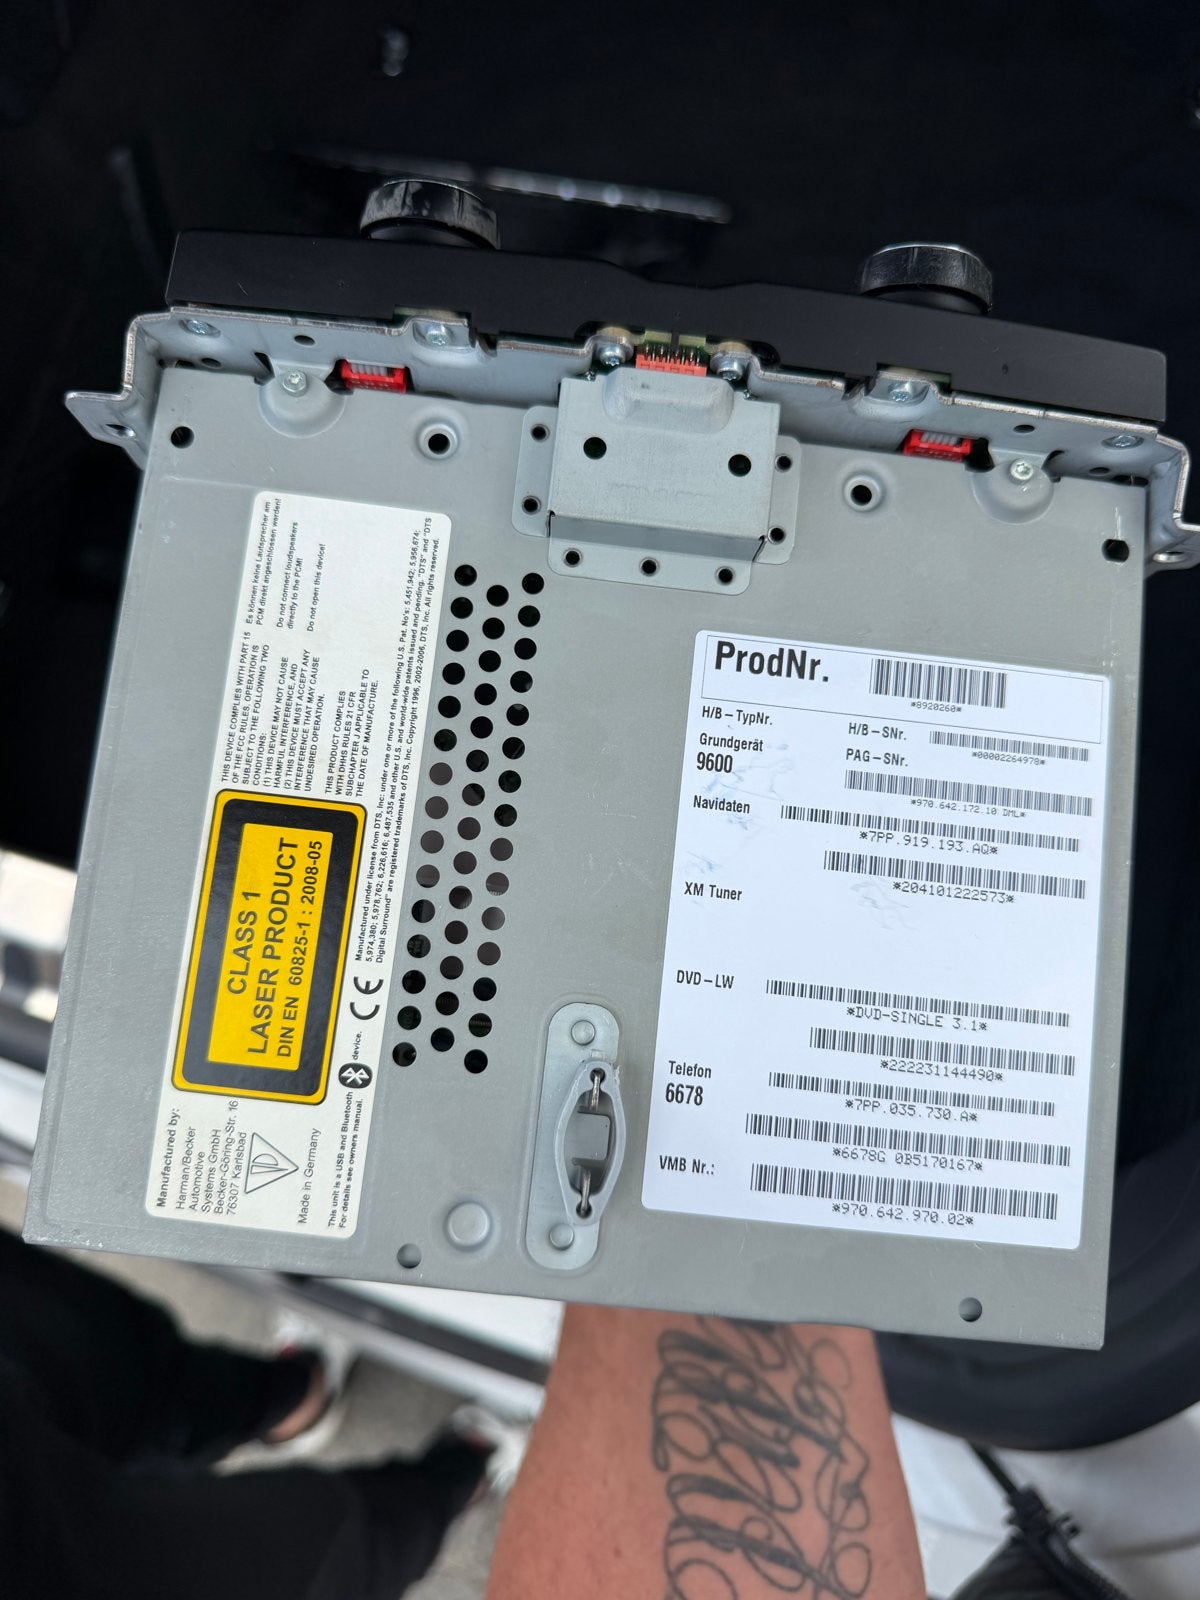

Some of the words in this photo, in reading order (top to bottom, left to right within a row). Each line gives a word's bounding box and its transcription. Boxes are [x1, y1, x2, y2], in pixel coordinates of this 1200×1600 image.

[263, 501, 271, 513] am
[272, 497, 281, 527] werden!
[254, 513, 268, 562] Lautsprecher
[284, 521, 298, 570] loudspeakers
[263, 528, 277, 584] angeschlossen
[293, 557, 303, 577] PCM!
[315, 543, 326, 570] device!
[251, 563, 261, 583] keine
[313, 570, 322, 585] this
[258, 584, 268, 606] direkt
[280, 571, 291, 602] connect
[290, 591, 298, 600] to
[291, 578, 300, 591] the
[311, 586, 319, 605] open
[246, 584, 258, 613] können
[244, 613, 254, 624] Es
[255, 606, 265, 625] PCM
[275, 616, 284, 628] Do
[286, 600, 298, 629] directly
[309, 606, 317, 619] not
[242, 631, 251, 640] 15
[305, 620, 315, 632] Do
[239, 641, 249, 664] PART
[251, 644, 259, 653] IS
[260, 643, 270, 663] TWO
[301, 648, 310, 667] ANY
[277, 656, 288, 685] CAUSE
[309, 656, 320, 684] CAUSE
[714, 640, 828, 682] ProdNr.
[235, 664, 246, 686] WITH
[243, 653, 258, 701] OPERATION
[296, 667, 307, 701] ACCEPT
[252, 664, 266, 713] FOLLOWING
[274, 685, 284, 703] NOT
[306, 685, 315, 703] MAY
[347, 690, 356, 708] CFR
[229, 687, 242, 729] COMPLIES
[238, 703, 250, 733] RULES.
[271, 704, 281, 722] MAY
[292, 701, 303, 725] MUST
[302, 704, 312, 726] THAT
[333, 690, 346, 732] COMPLIES
[345, 709, 353, 719] 21
[362, 680, 378, 743] MANUFACTURE.
[249, 715, 259, 731] THE
[272, 748, 286, 788] HARMFUL
[279, 682, 296, 746] INTERFERENCE,
[288, 662, 298, 681] AND
[341, 720, 352, 748] RULES
[344, 740, 360, 796] SUBCHAPTER
[354, 681, 368, 733] APPLICABLE
[361, 668, 369, 680] TO
[387, 721, 395, 741] more
[223, 731, 236, 762] DEVICE
[235, 734, 246, 752] FCC
[247, 732, 256, 744] TO
[267, 724, 279, 754] DEVICE
[287, 726, 299, 757] DEVICE
[303, 743, 317, 791] UNDESIRED
[311, 693, 325, 742] OPERATION.
[385, 742, 392, 751] or
[699, 732, 763, 752] Grundgerät
[252, 732, 267, 786] CONDITIONS:
[293, 727, 309, 790] INTERFERENCE
[327, 733, 340, 774] PRODUCT
[337, 749, 348, 773] DHHS
[361, 744, 369, 756] OF
[383, 752, 391, 768] one
[220, 763, 231, 782] THIS
[233, 753, 243, 770] THE
[241, 746, 254, 784] SUBJECT
[263, 755, 274, 775] THIS
[284, 758, 295, 777] THIS
[357, 757, 368, 779] DATE
[696, 751, 733, 773] 9600
[231, 771, 239, 783] OF
[262, 776, 272, 787] (1)
[283, 778, 292, 789] (2)
[324, 775, 334, 794] THIS
[334, 773, 345, 795] WITH
[380, 768, 388, 792] under
[354, 780, 364, 797] THE
[376, 793, 385, 808] Inc:
[693, 794, 750, 814] Navidaten
[373, 810, 383, 829] DTS,
[370, 830, 380, 849] from
[300, 840, 322, 905] 2008-05
[366, 850, 377, 879] license
[241, 890, 261, 900] 1
[261, 836, 298, 960] PRODUCT
[364, 880, 373, 904] under
[683, 881, 704, 896] XM
[708, 884, 742, 901] Tuner
[354, 905, 369, 961] Manufactured
[226, 910, 257, 994] CLASS
[288, 921, 310, 985] 60825-1
[247, 968, 279, 1053] LASER
[282, 995, 299, 1020] EN
[276, 1026, 295, 1057] DIN
[351, 1030, 362, 1060] device.
[668, 1059, 711, 1078] Telefon
[664, 1082, 703, 1106] 6678
[340, 1091, 353, 1132] Bluetooth
[352, 1098, 363, 1131] manual.
[207, 1128, 221, 1164] GmbH
[303, 1127, 321, 1178] Germany
[339, 1133, 347, 1151] and
[348, 1133, 358, 1165] owners
[155, 1128, 176, 1207] Manufactured
[167, 1107, 181, 1126] by:
[212, 1115, 236, 1214] Becker-Göring-Str.
[227, 1099, 239, 1111] 16
[231, 1131, 247, 1179] Karlsbad
[335, 1152, 345, 1171] USB
[659, 1154, 686, 1172] VMB
[691, 1158, 714, 1175] Nr.:
[175, 1125, 196, 1209] Harman/Becker
[188, 1150, 205, 1211] Automotive
[200, 1166, 216, 1214] Systems
[301, 1180, 312, 1191] in
[332, 1180, 341, 1188] is
[225, 1181, 239, 1215] 76307
[297, 1193, 310, 1223] Made
[331, 1189, 340, 1207] unit
[341, 1183, 351, 1212] details
[327, 1208, 337, 1227] This
[337, 1213, 347, 1228] For
